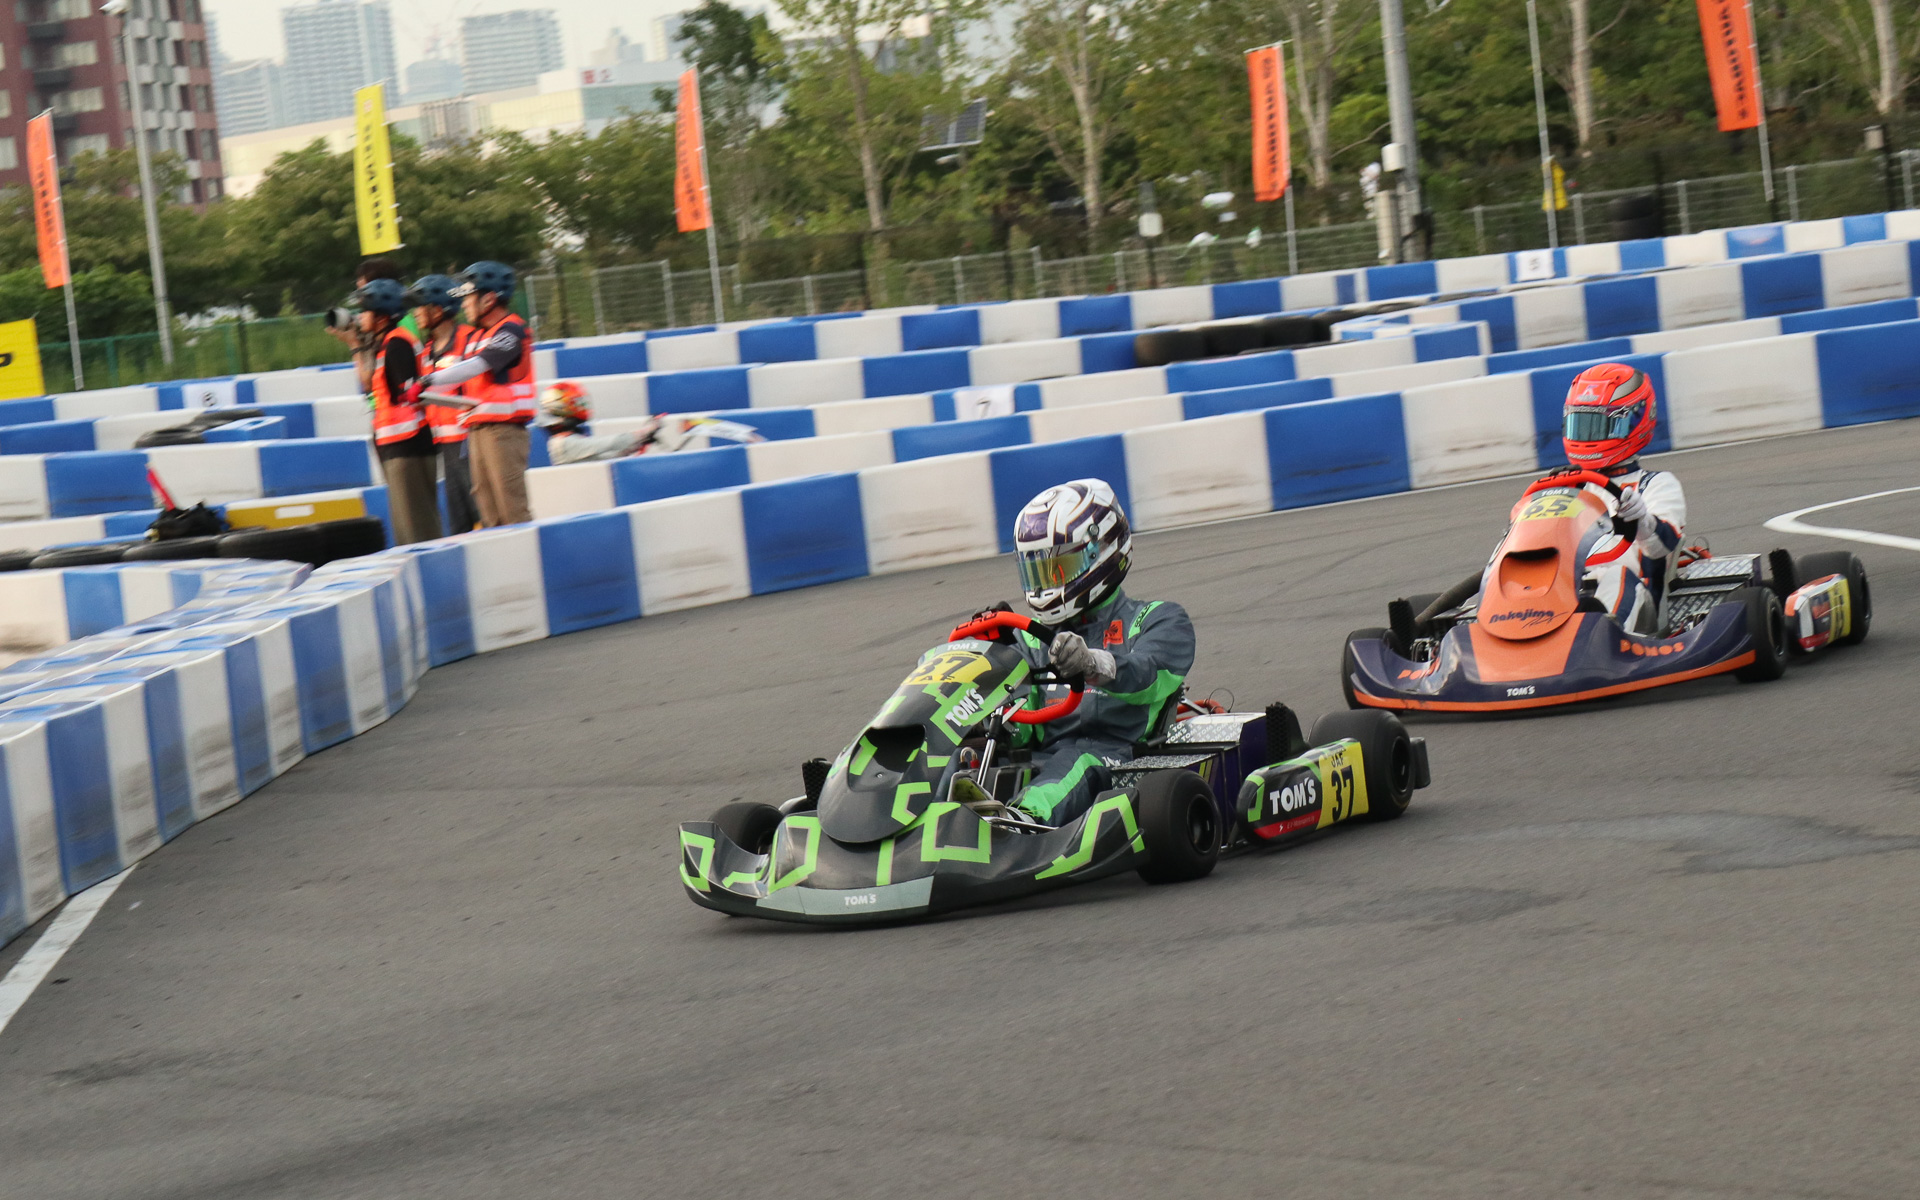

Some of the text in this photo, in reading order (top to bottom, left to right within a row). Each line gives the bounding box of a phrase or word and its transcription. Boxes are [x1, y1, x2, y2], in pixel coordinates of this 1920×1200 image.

[1541, 488, 1570, 497] TOM'S
[1524, 499, 1571, 518] 65
[1489, 609, 1555, 624] nakajima
[946, 641, 979, 652] TOM'S
[910, 656, 978, 681] 37
[1506, 685, 1536, 698] TOM'S
[945, 687, 985, 727] TOM'S
[1269, 777, 1316, 815] TOM'S
[1331, 765, 1354, 823] 37
[844, 893, 877, 906] TOM'S
